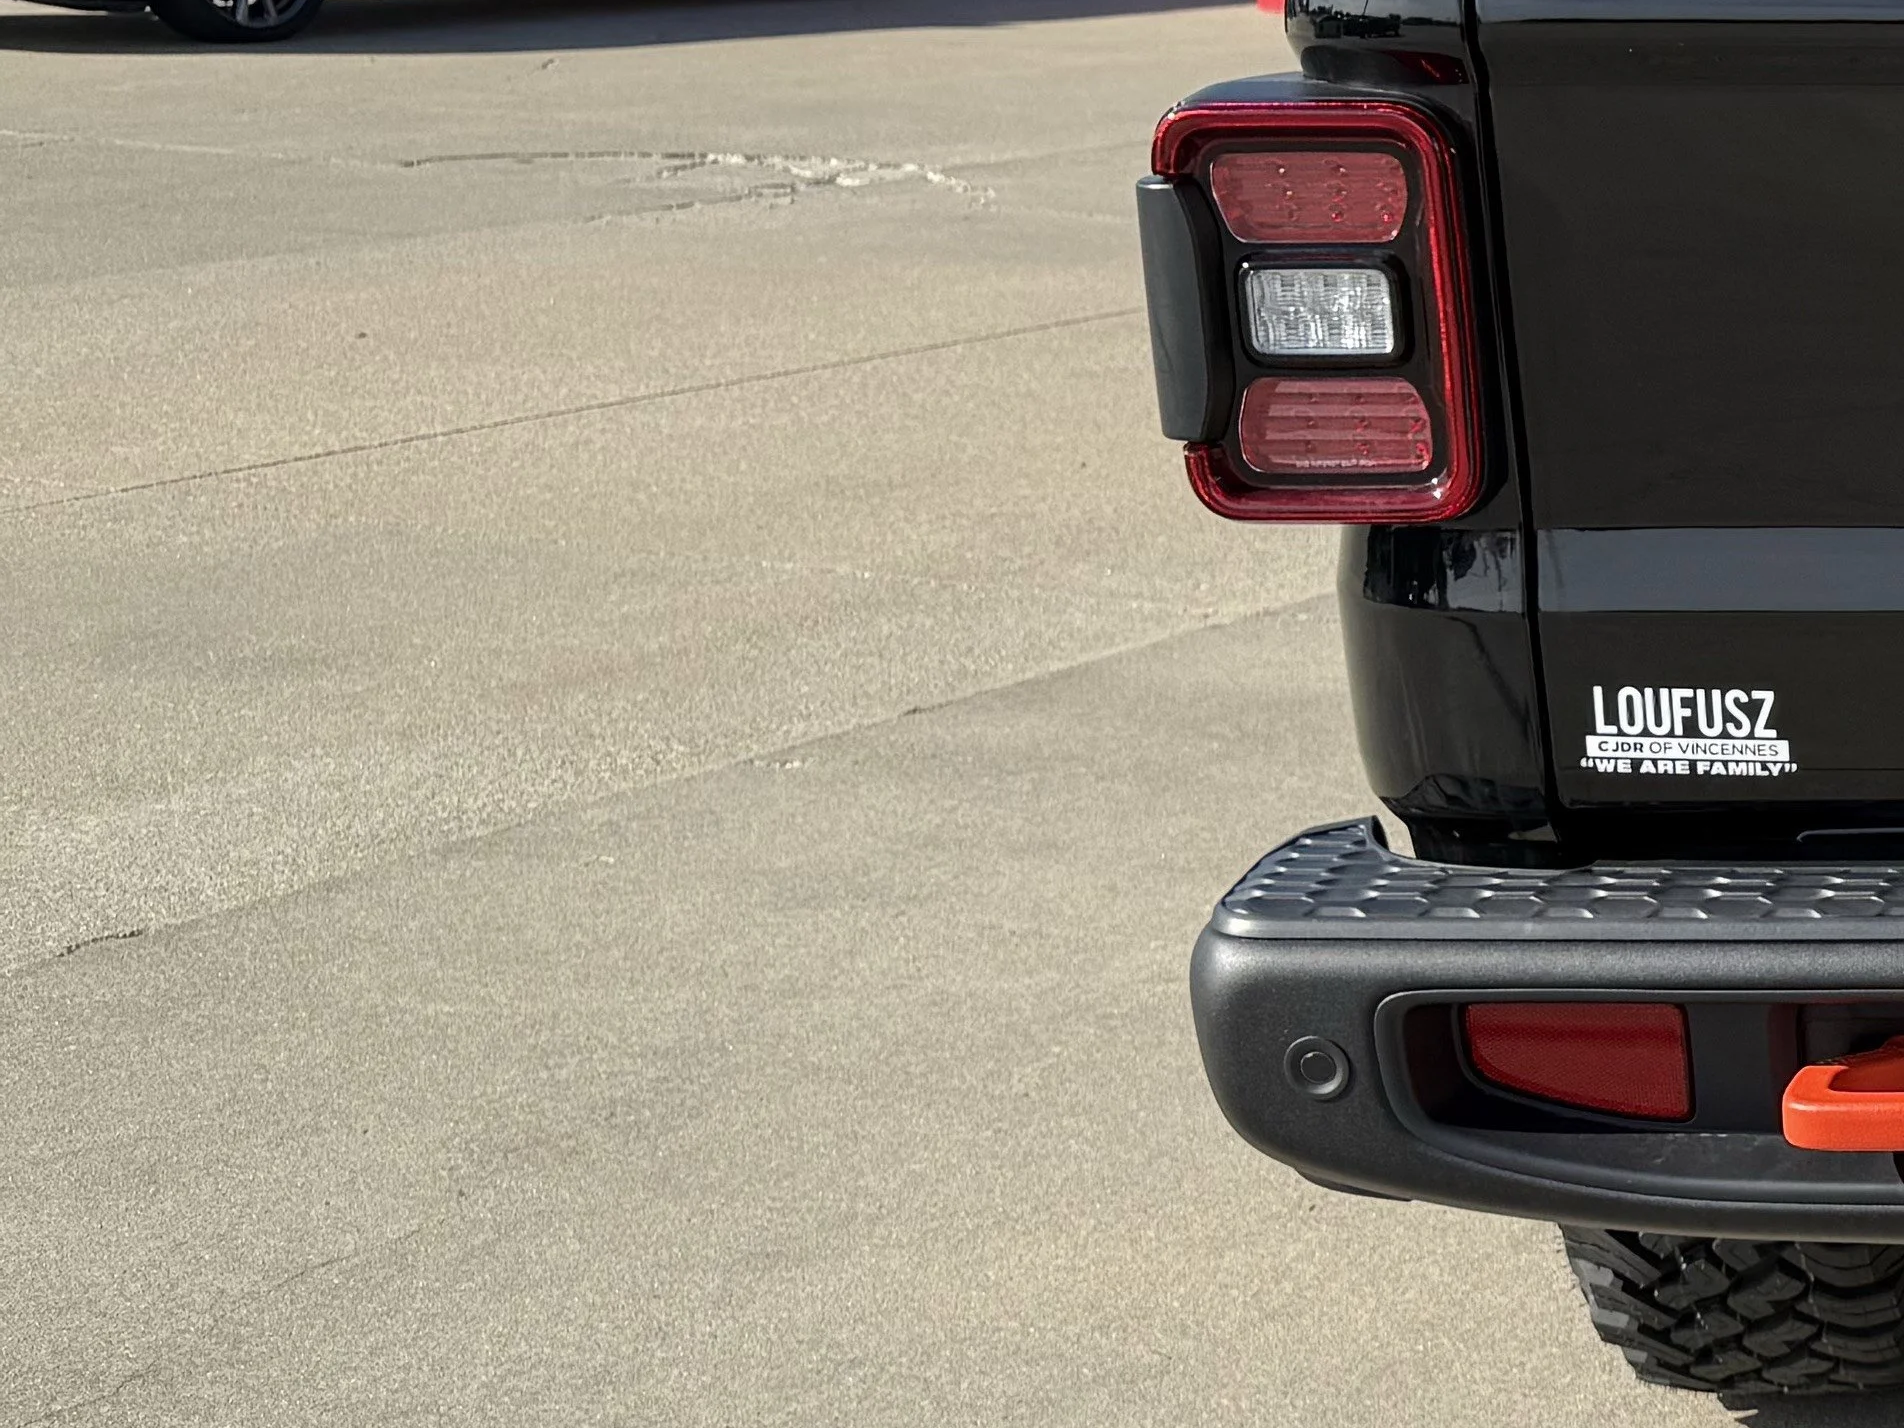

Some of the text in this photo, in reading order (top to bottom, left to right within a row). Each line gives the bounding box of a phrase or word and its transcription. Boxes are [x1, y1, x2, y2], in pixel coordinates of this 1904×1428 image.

[1598, 740, 1779, 756] CJDR OF VINCENNES
[1640, 760, 1690, 775] ARE
